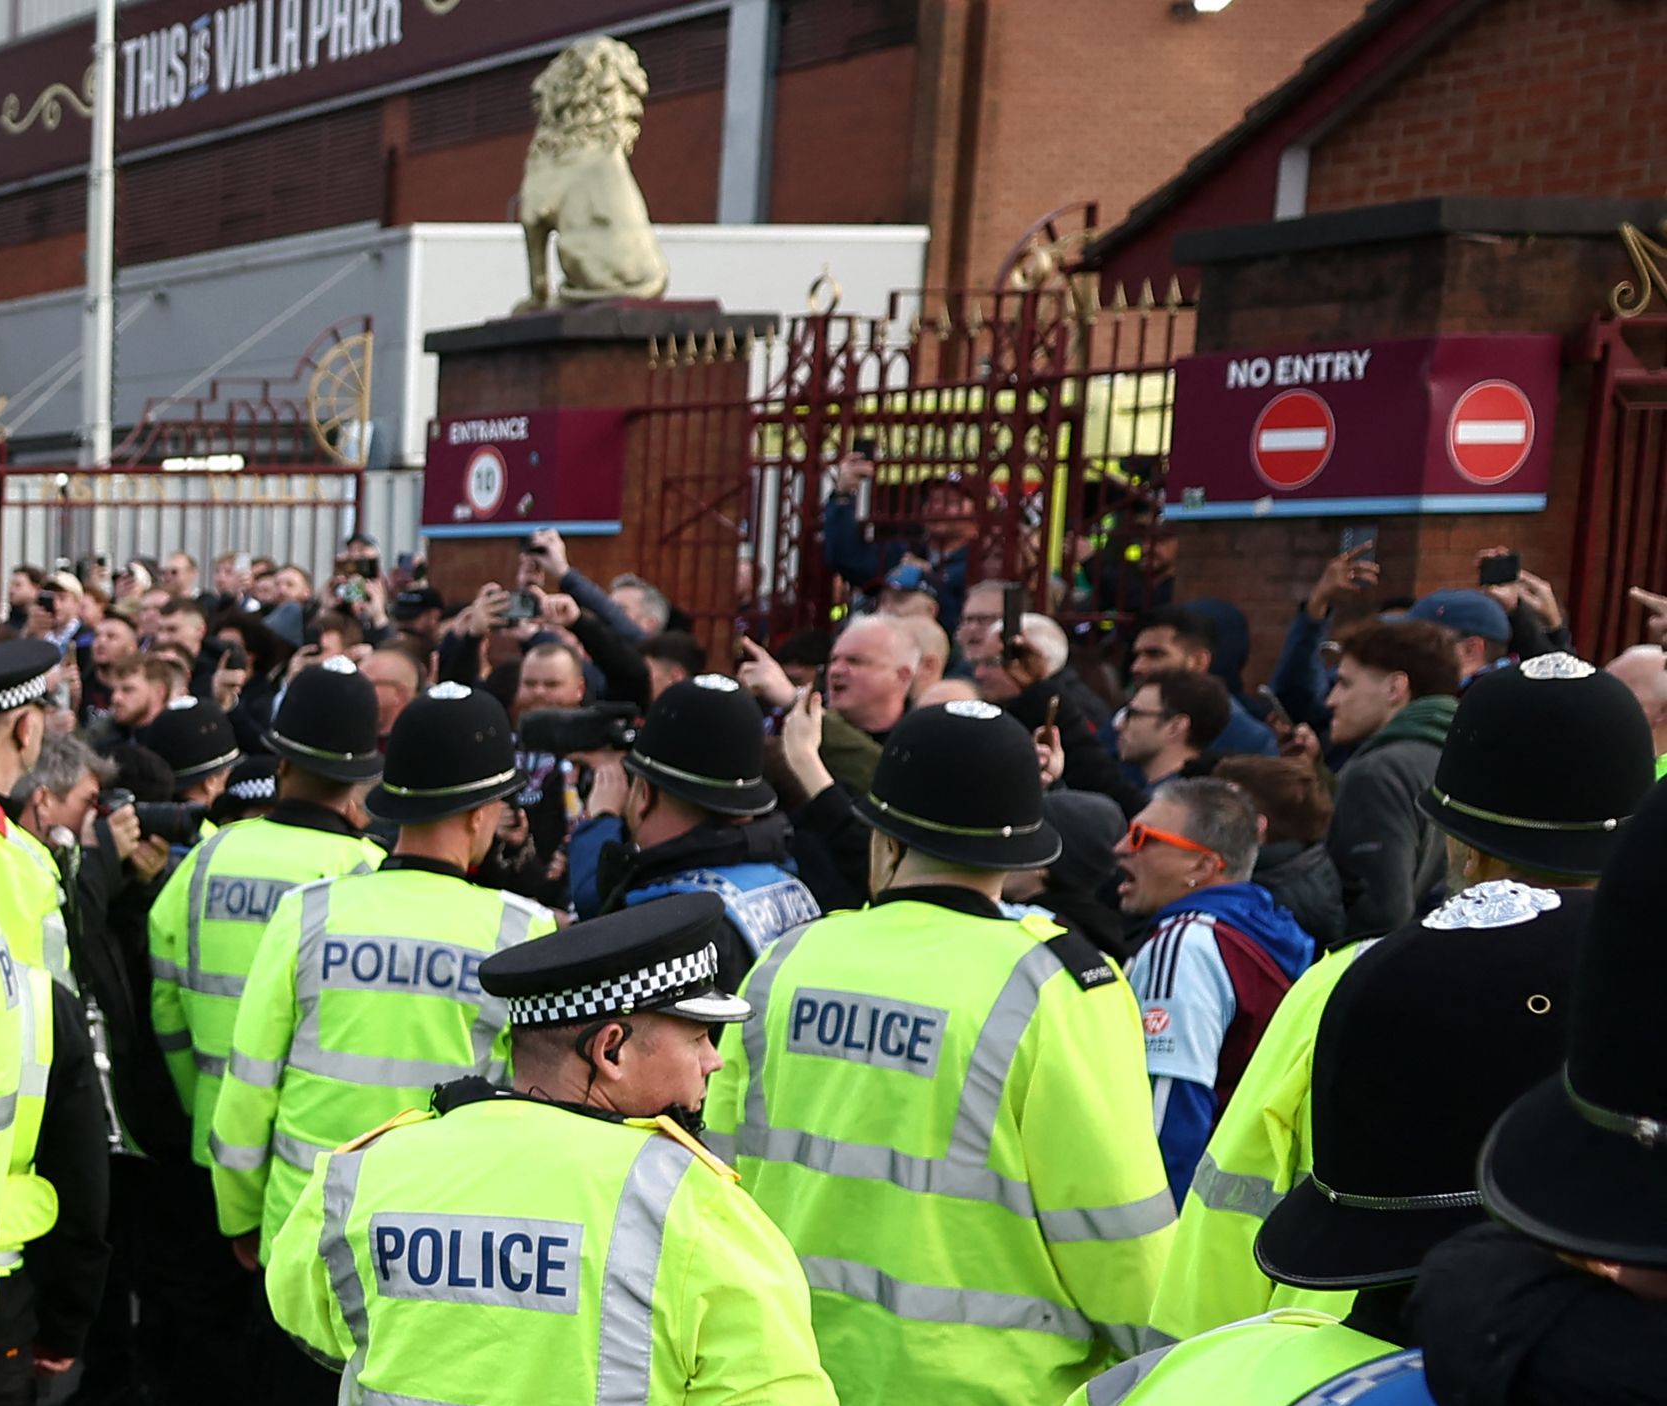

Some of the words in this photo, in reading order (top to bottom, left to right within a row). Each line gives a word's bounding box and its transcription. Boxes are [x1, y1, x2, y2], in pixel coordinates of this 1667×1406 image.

[120, 22, 188, 120] THIS
[188, 26, 212, 88] IS
[214, 0, 302, 93] VILLA
[1226, 357, 1272, 389] NO
[1273, 349, 1372, 386] ENTRY
[449, 416, 530, 445] ENTRANCE
[747, 888, 813, 936] POLICE
[322, 941, 483, 995] POLICE
[793, 997, 937, 1064] POLICE
[376, 1226, 569, 1297] POLICE
